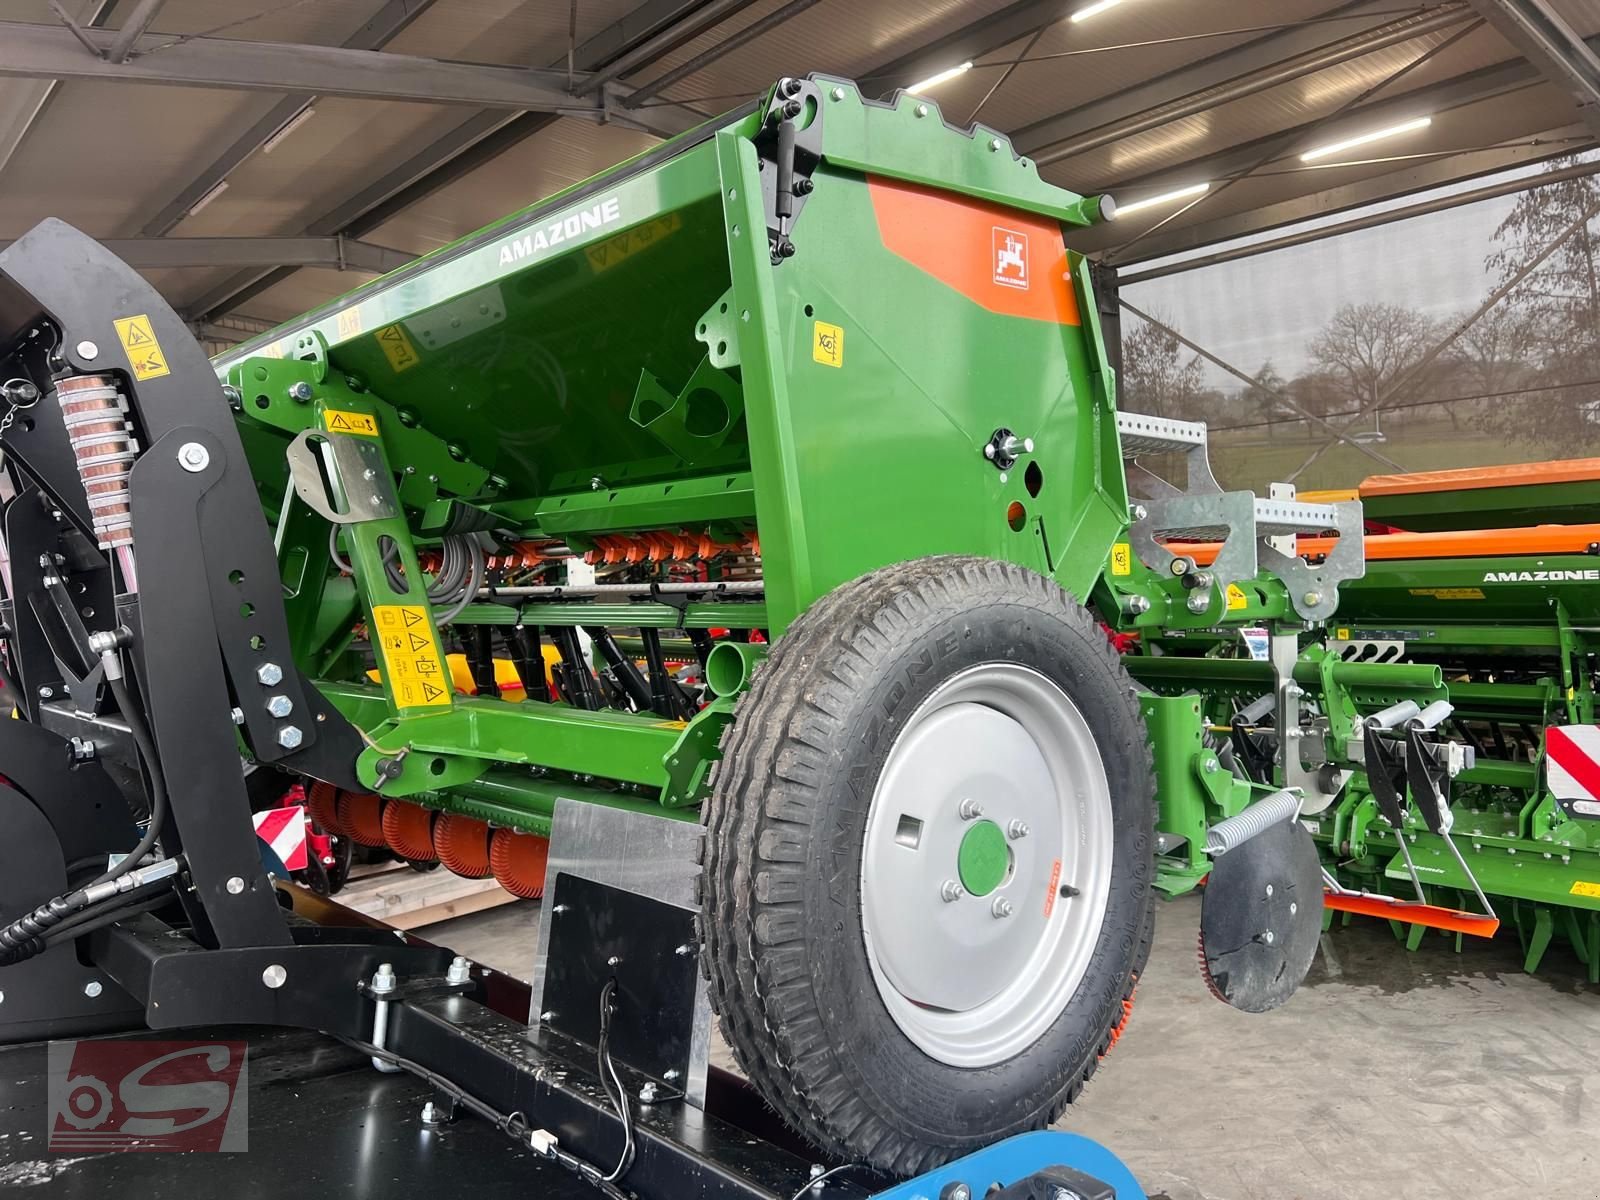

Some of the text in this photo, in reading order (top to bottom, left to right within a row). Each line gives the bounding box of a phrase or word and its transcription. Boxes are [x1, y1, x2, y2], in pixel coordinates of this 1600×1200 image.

[499, 197, 620, 266] AMAZONE
[995, 275, 1027, 287] AMAZONE
[1483, 570, 1599, 582] AMAZONE
[829, 630, 960, 907] AMAZONE
